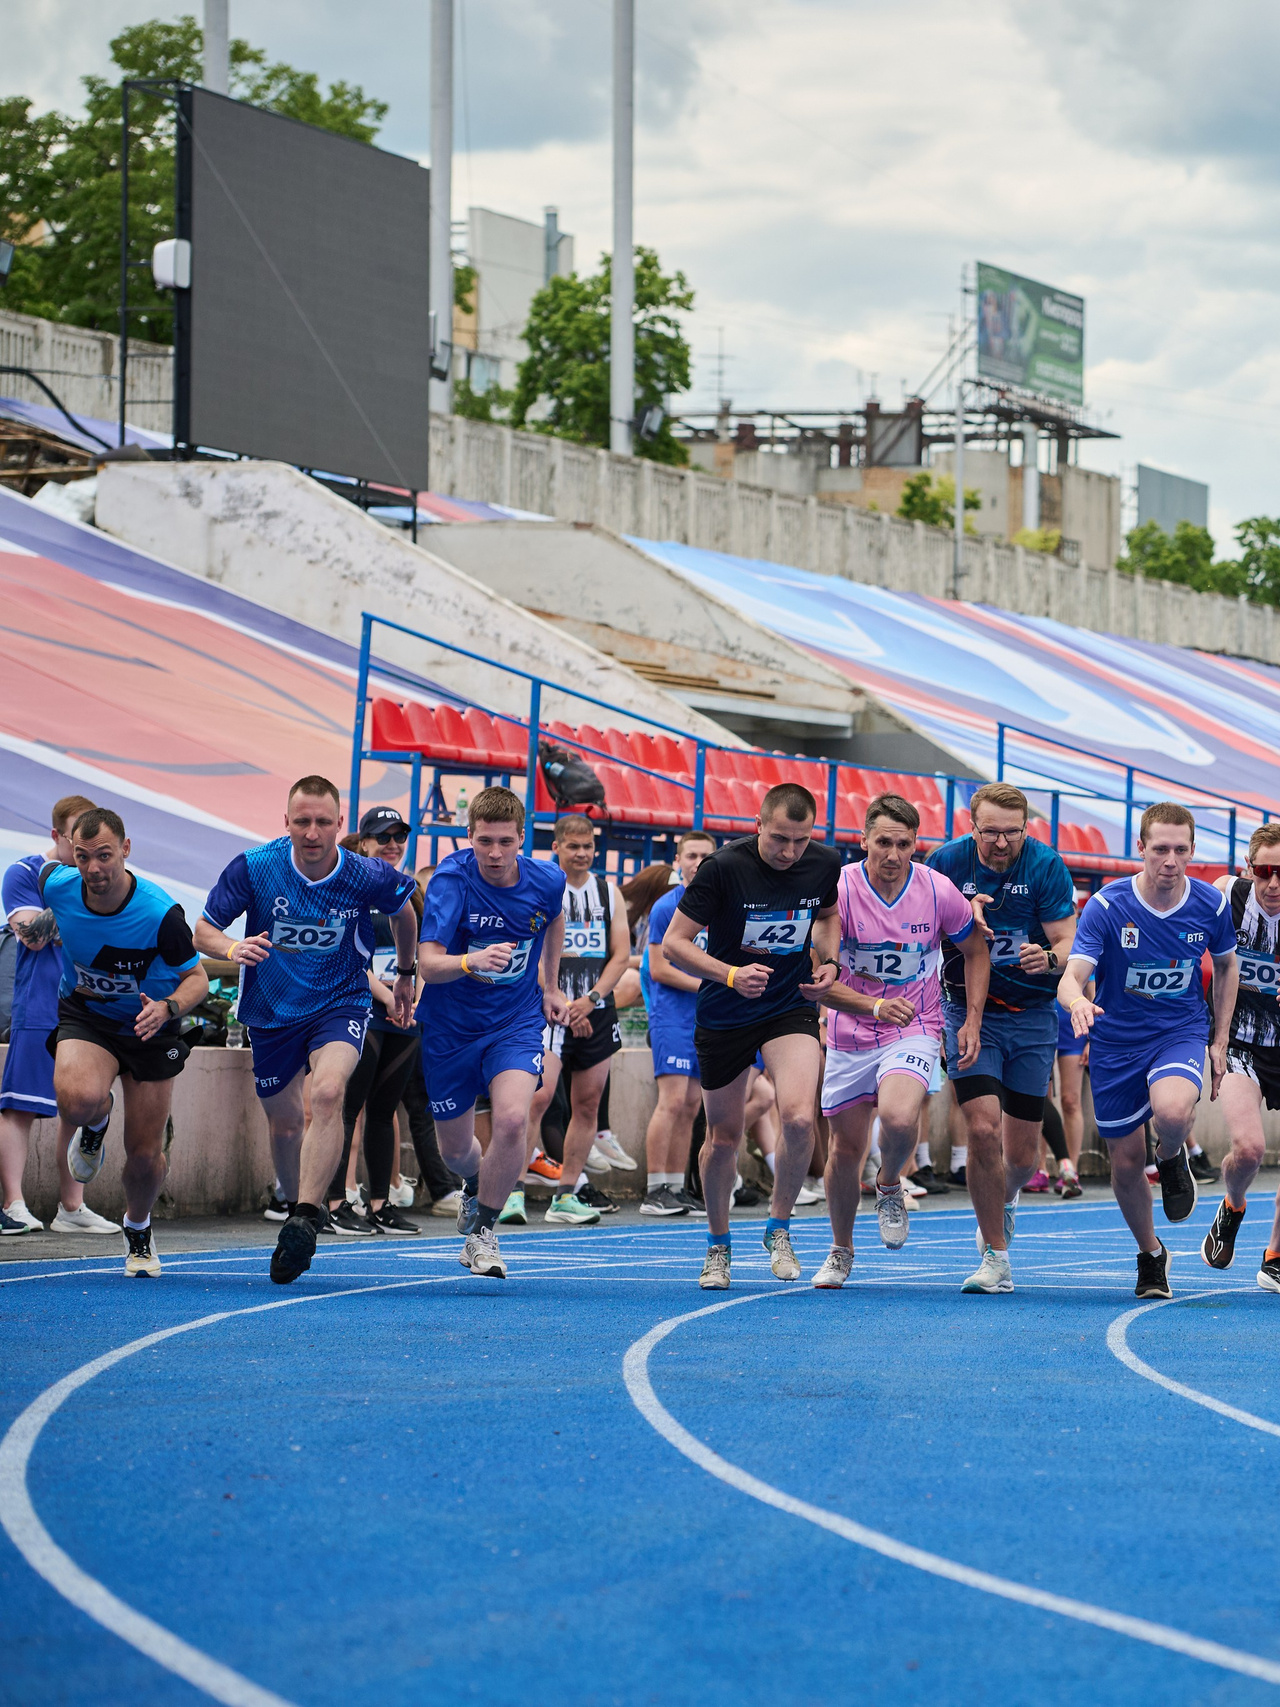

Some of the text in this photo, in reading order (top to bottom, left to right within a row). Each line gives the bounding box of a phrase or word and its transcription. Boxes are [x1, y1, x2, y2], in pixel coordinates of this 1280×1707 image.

[271, 896, 290, 917] 8
[806, 897, 821, 908] ВТБ
[338, 908, 359, 920] ВТБ
[279, 926, 338, 948] 202
[758, 924, 797, 944] 42
[910, 923, 931, 934] ВТБ
[564, 932, 601, 949] 505
[1187, 932, 1205, 943] ВТБ
[873, 953, 902, 976] 12
[1135, 971, 1185, 990] 102
[347, 1019, 361, 1040] 8
[676, 1058, 691, 1070] ВТБ
[906, 1054, 931, 1073] ВТБ
[260, 1076, 280, 1088] ВТБ
[431, 1098, 457, 1113] ВТБ
